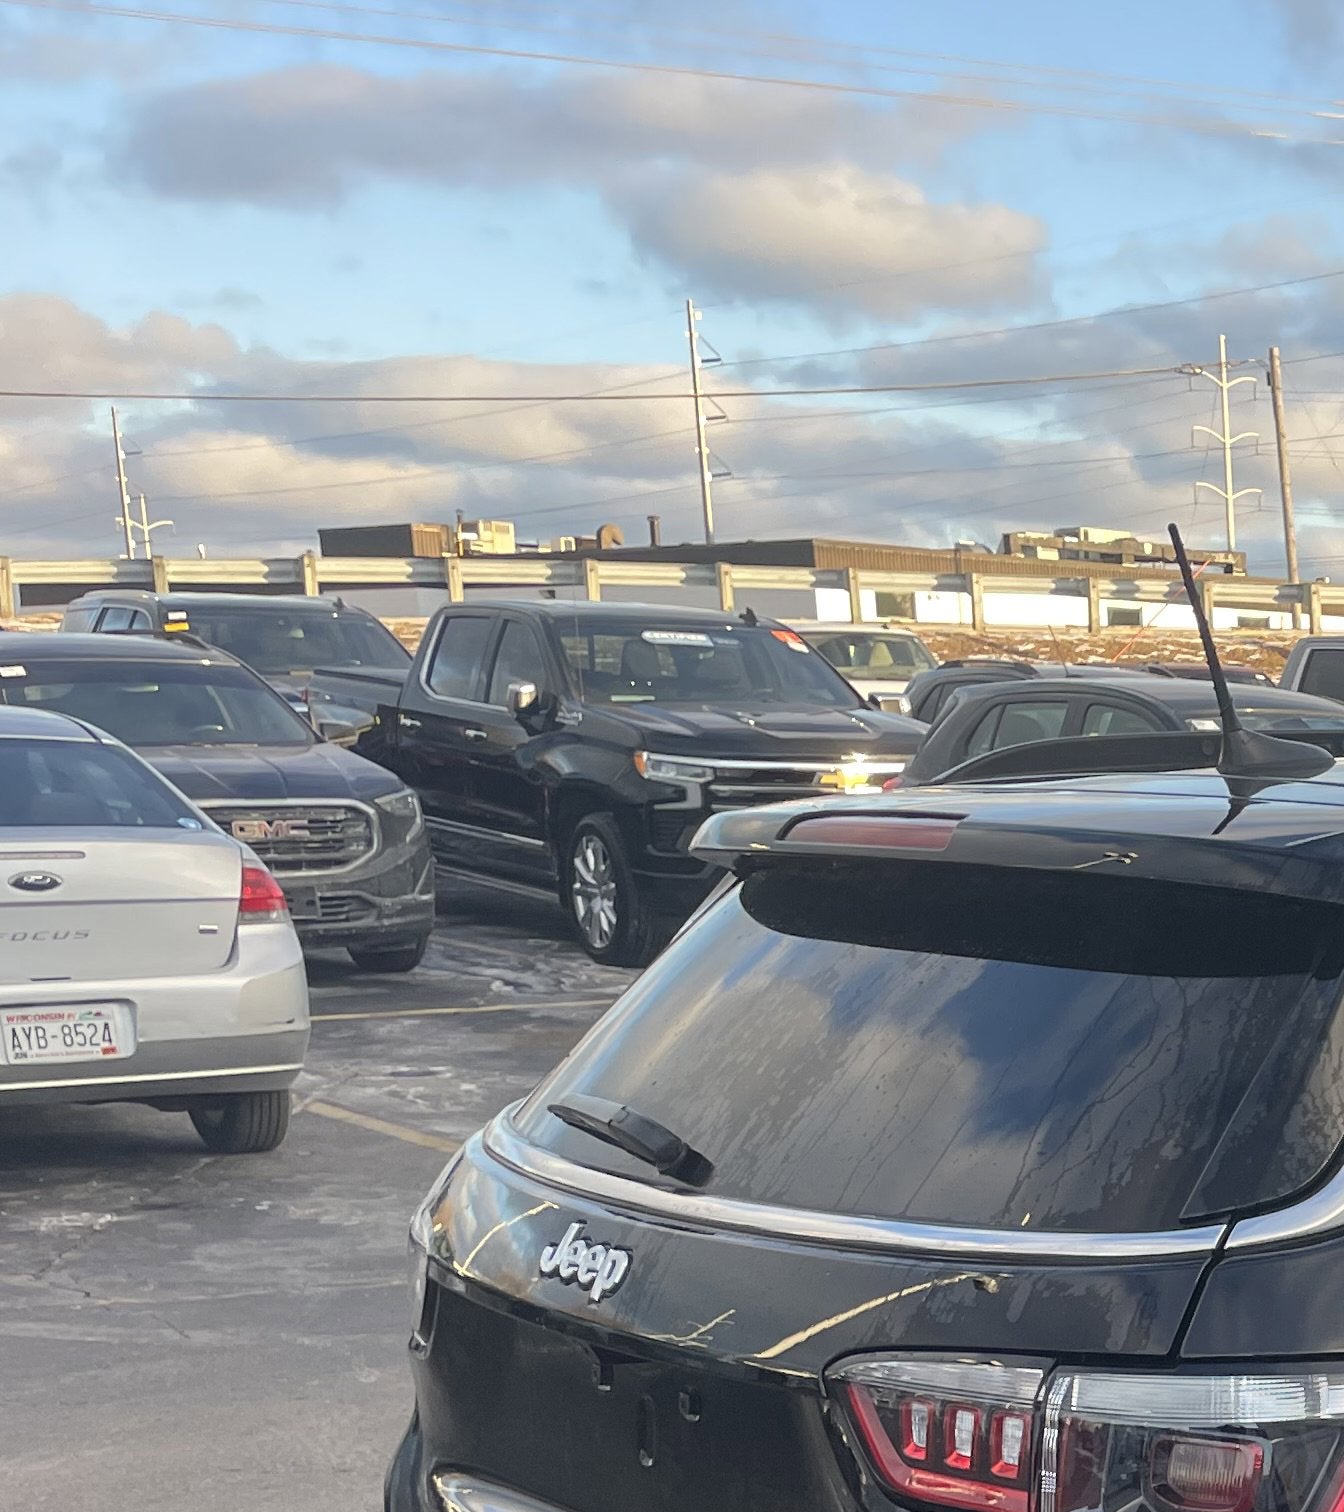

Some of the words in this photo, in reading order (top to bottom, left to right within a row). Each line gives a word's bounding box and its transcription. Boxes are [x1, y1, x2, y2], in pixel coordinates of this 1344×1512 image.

[231, 819, 310, 839] GMC
[5, 1012, 66, 1023] WISCONSIN
[11, 1021, 113, 1052] AYB-8524
[539, 1220, 633, 1304] Jeep
